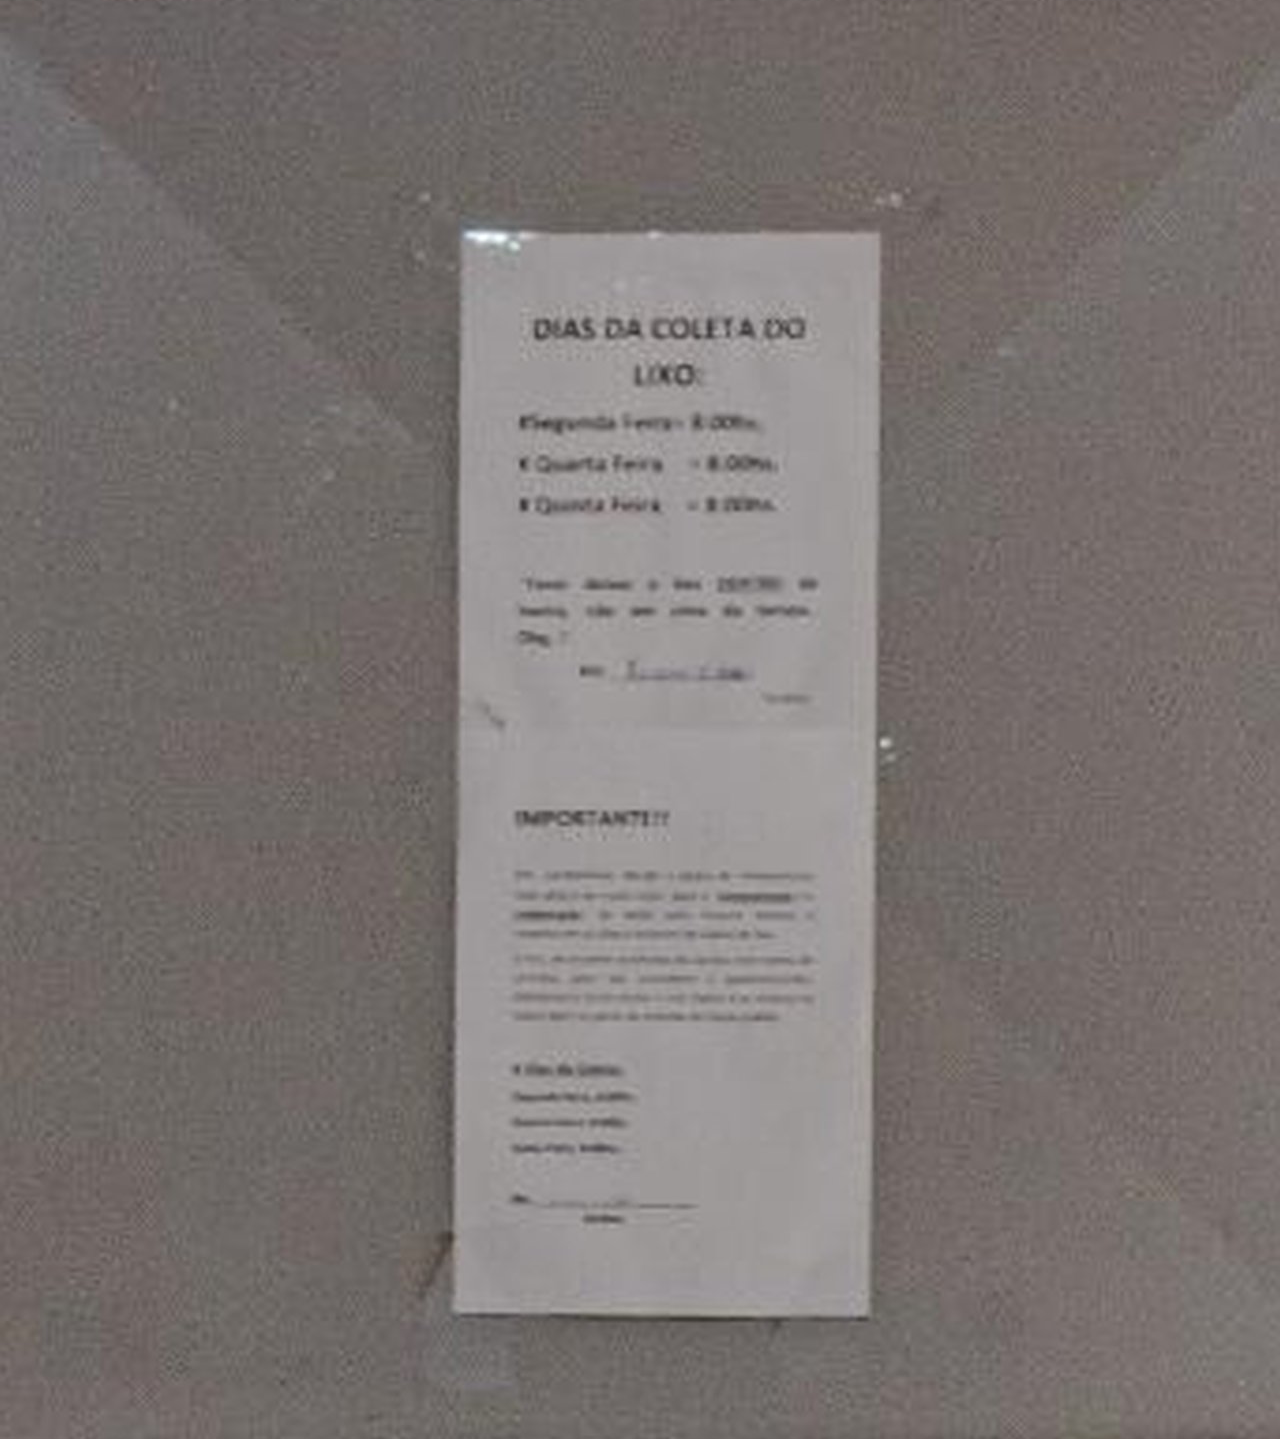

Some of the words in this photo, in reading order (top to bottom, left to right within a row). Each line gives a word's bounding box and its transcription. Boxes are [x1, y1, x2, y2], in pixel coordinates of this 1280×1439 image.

[533, 317, 596, 341] DIAS
[604, 317, 641, 341] DA
[651, 317, 756, 340] COLETA
[765, 317, 807, 339] DO
